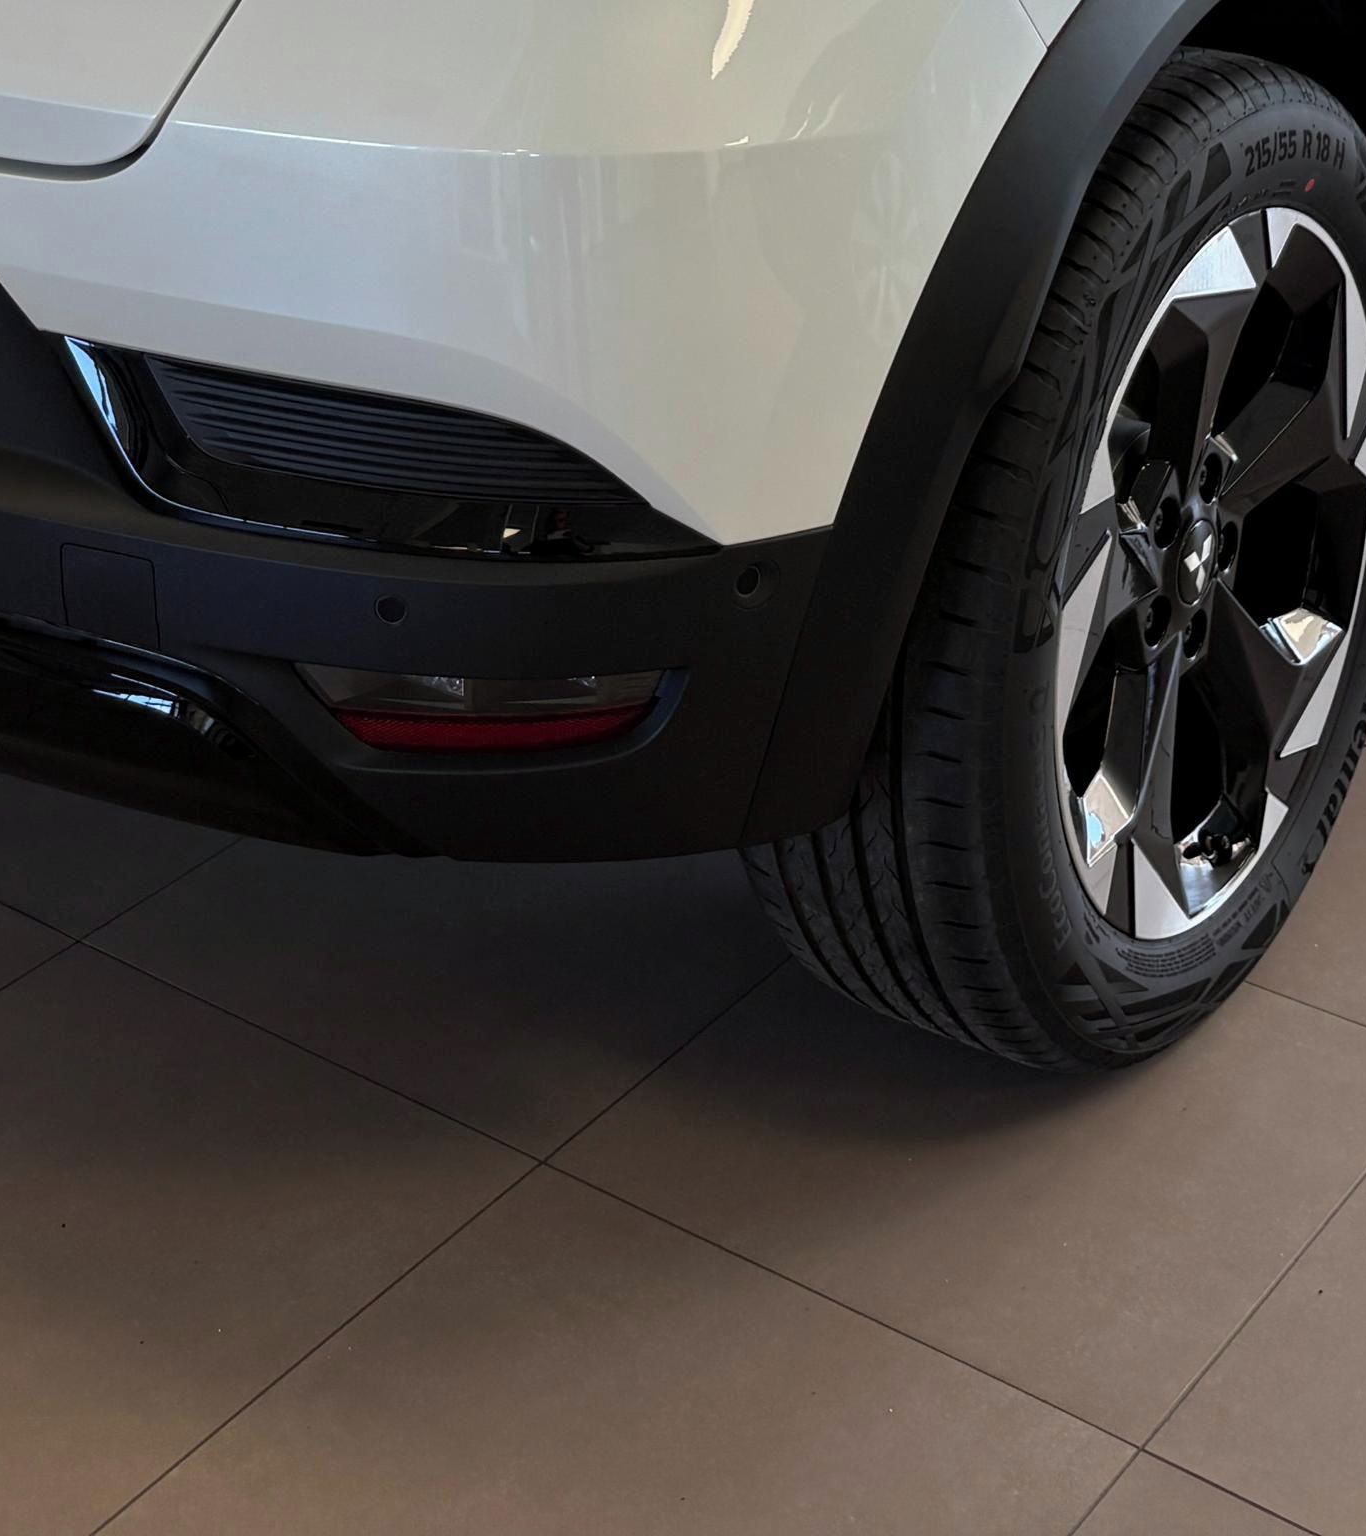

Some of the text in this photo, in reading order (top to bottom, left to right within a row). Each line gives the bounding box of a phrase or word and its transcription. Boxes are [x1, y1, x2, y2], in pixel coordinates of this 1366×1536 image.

[1243, 128, 1298, 178] 215/55
[1302, 128, 1313, 159] R
[1315, 130, 1331, 163] 18
